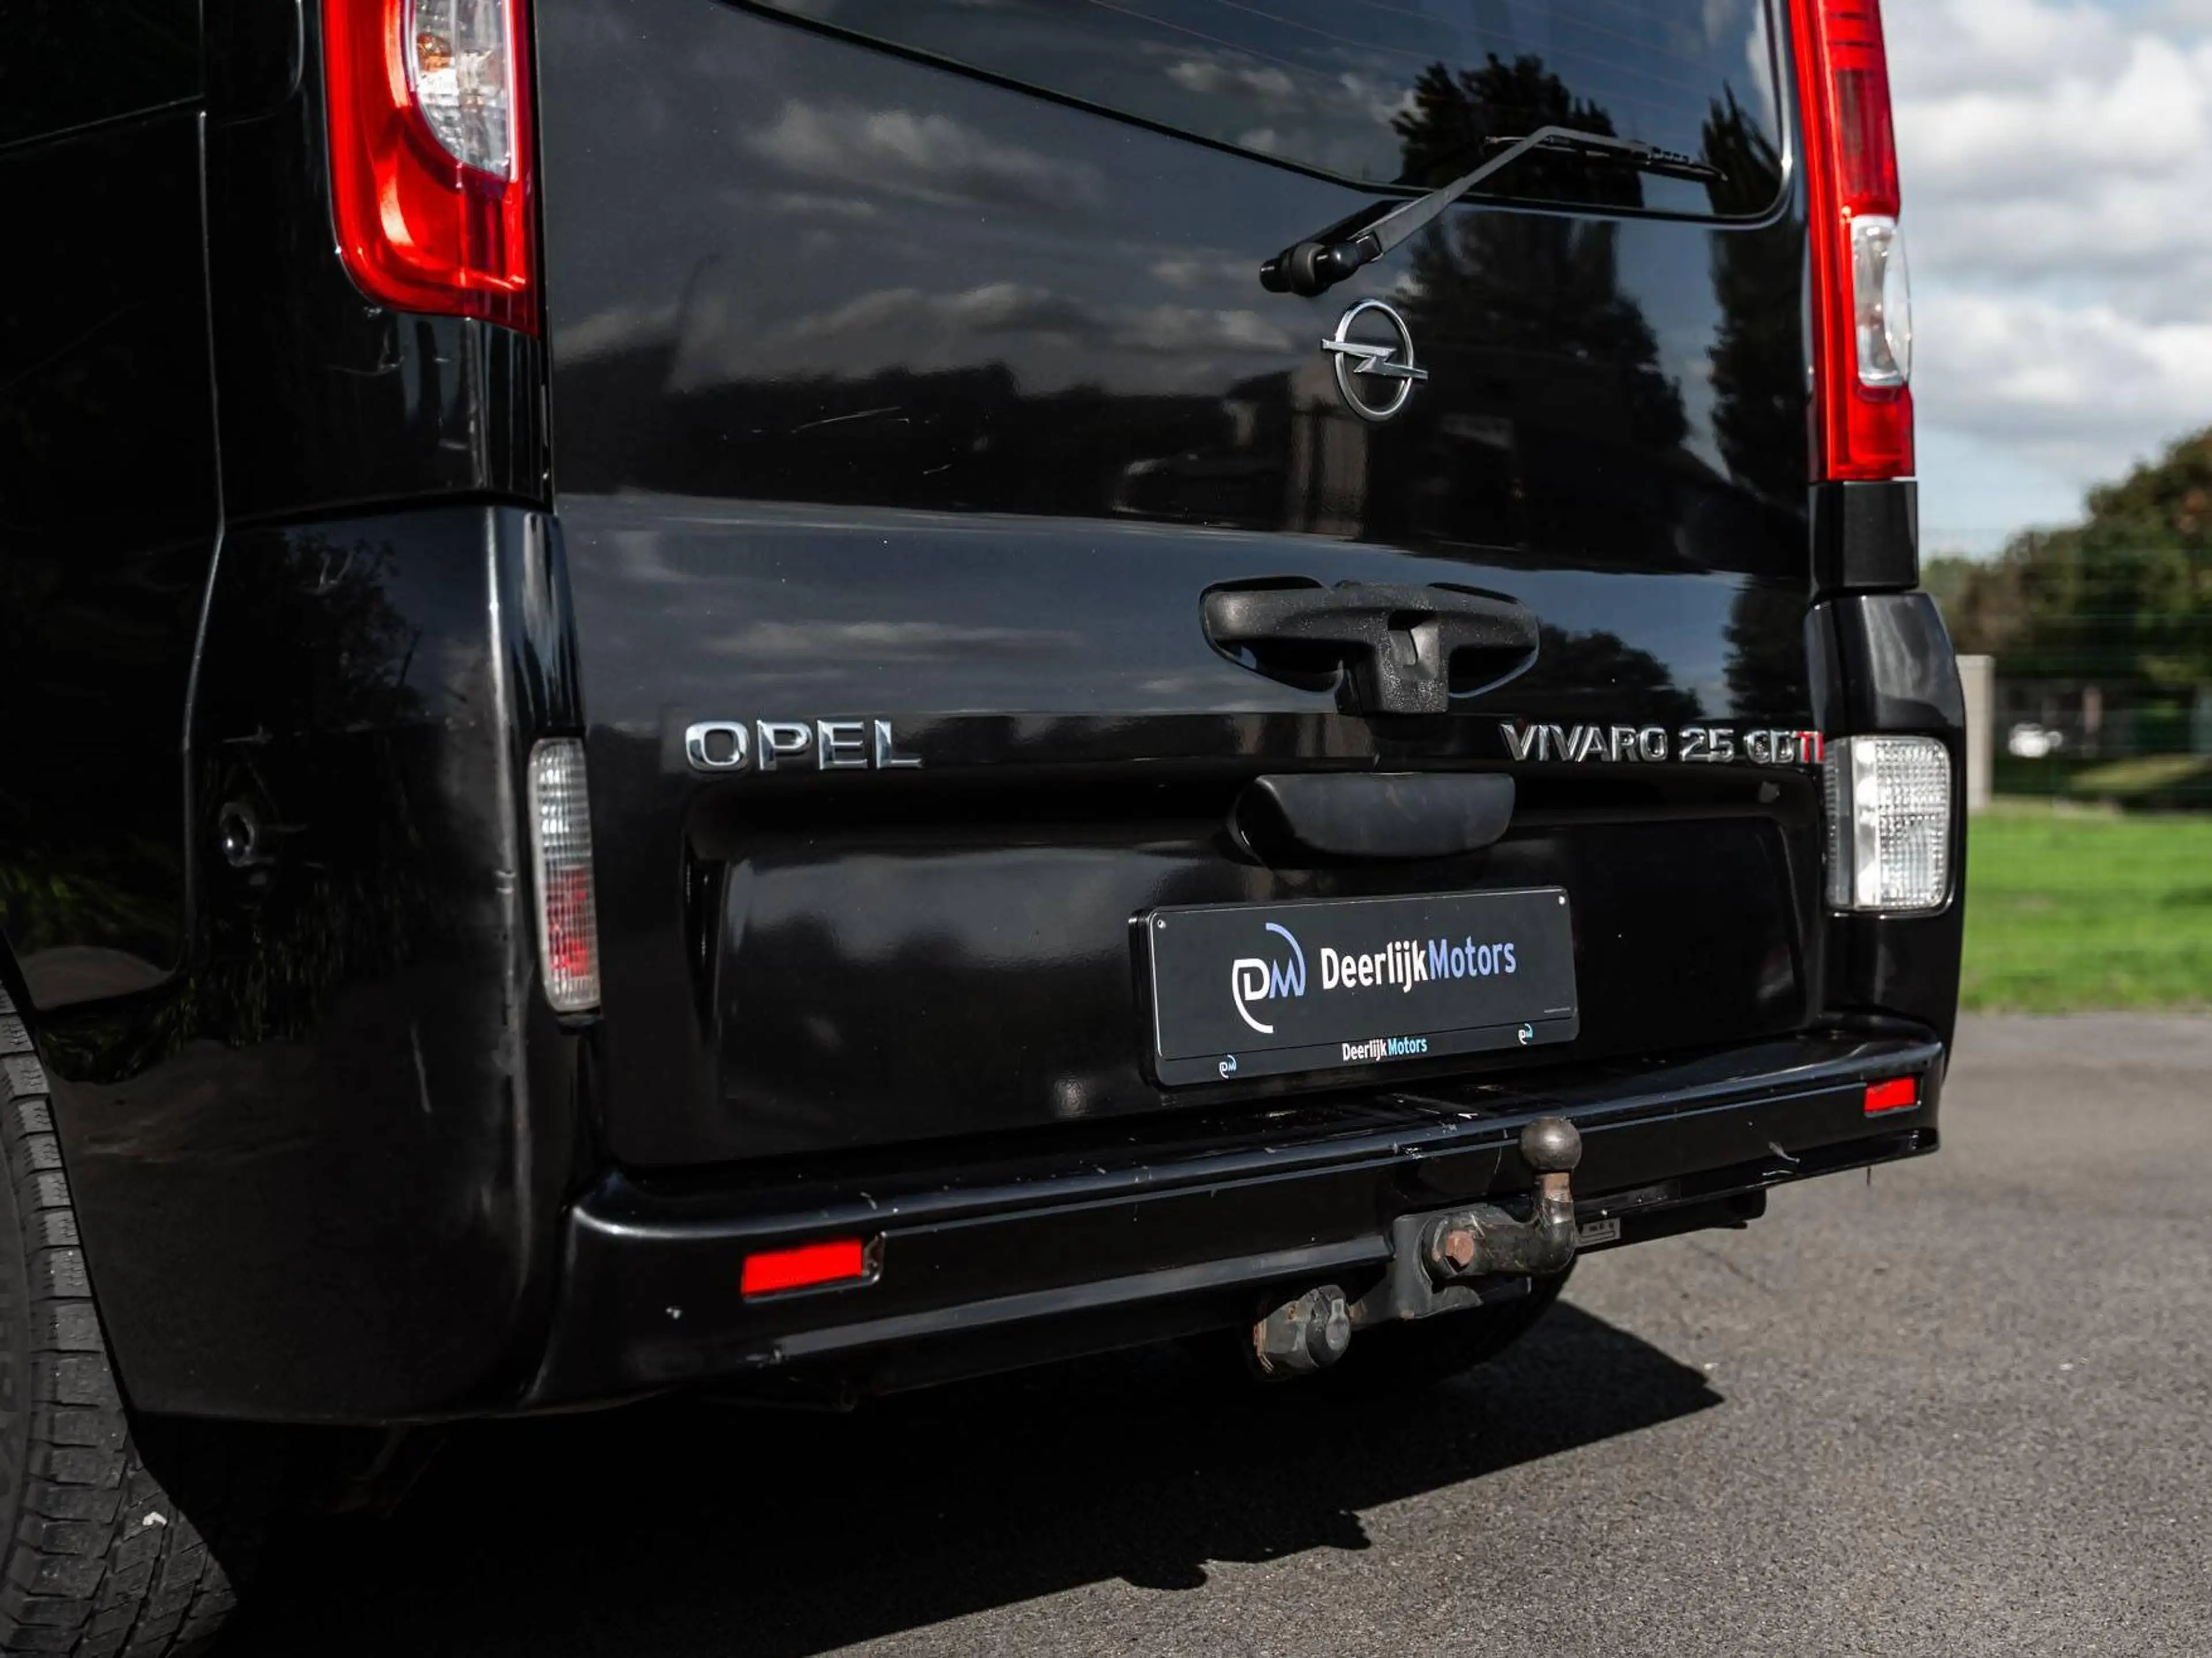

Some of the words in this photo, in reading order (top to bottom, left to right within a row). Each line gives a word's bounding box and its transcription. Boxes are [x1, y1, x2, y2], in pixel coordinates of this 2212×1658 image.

[685, 720, 923, 771] OPEL
[1500, 724, 1668, 762] VIVARO
[1743, 728, 1825, 764] CDTI
[1320, 936, 1517, 993] DeerlijkMotors
[1342, 1037, 1427, 1061] DeerlijkMotors
